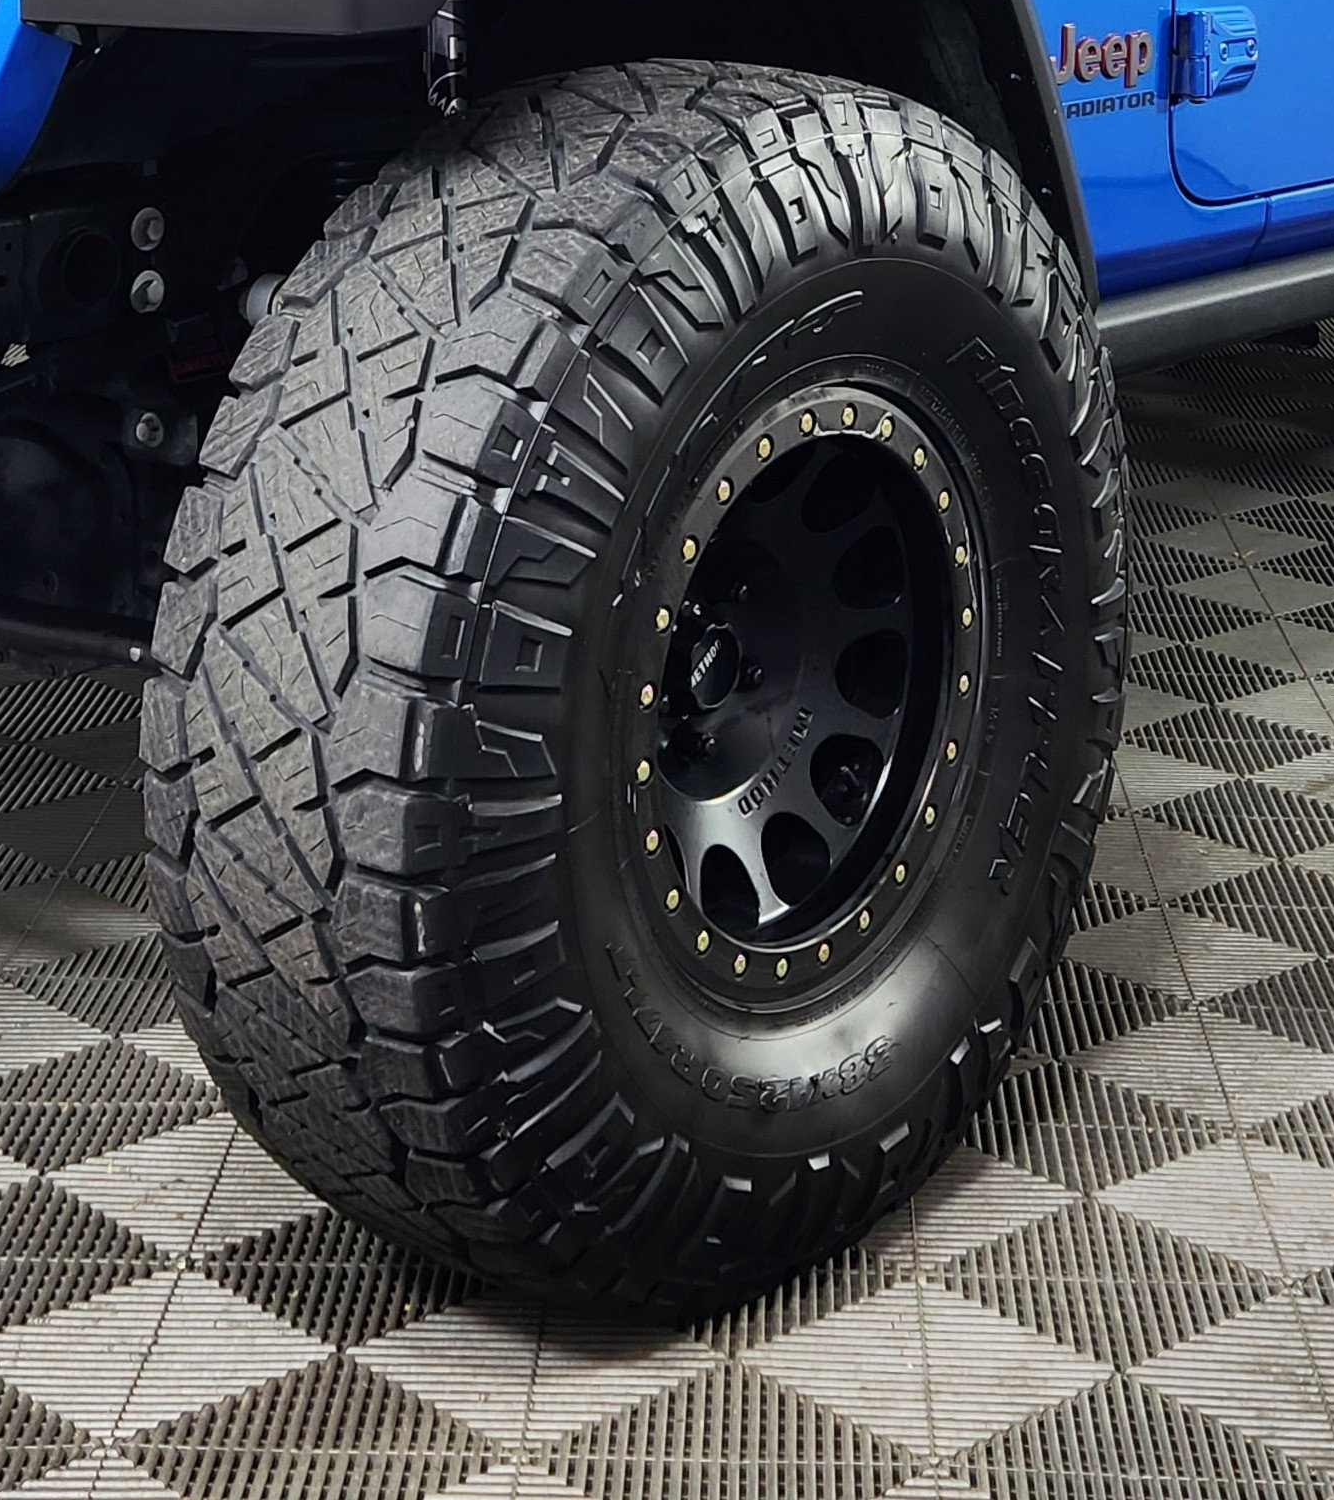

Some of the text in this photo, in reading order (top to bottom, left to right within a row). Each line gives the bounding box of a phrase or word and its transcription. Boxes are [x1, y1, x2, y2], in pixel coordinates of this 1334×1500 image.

[1049, 22, 1155, 88] Jeep
[1066, 90, 1156, 119] ADIATOR
[738, 706, 815, 819] METHOD
